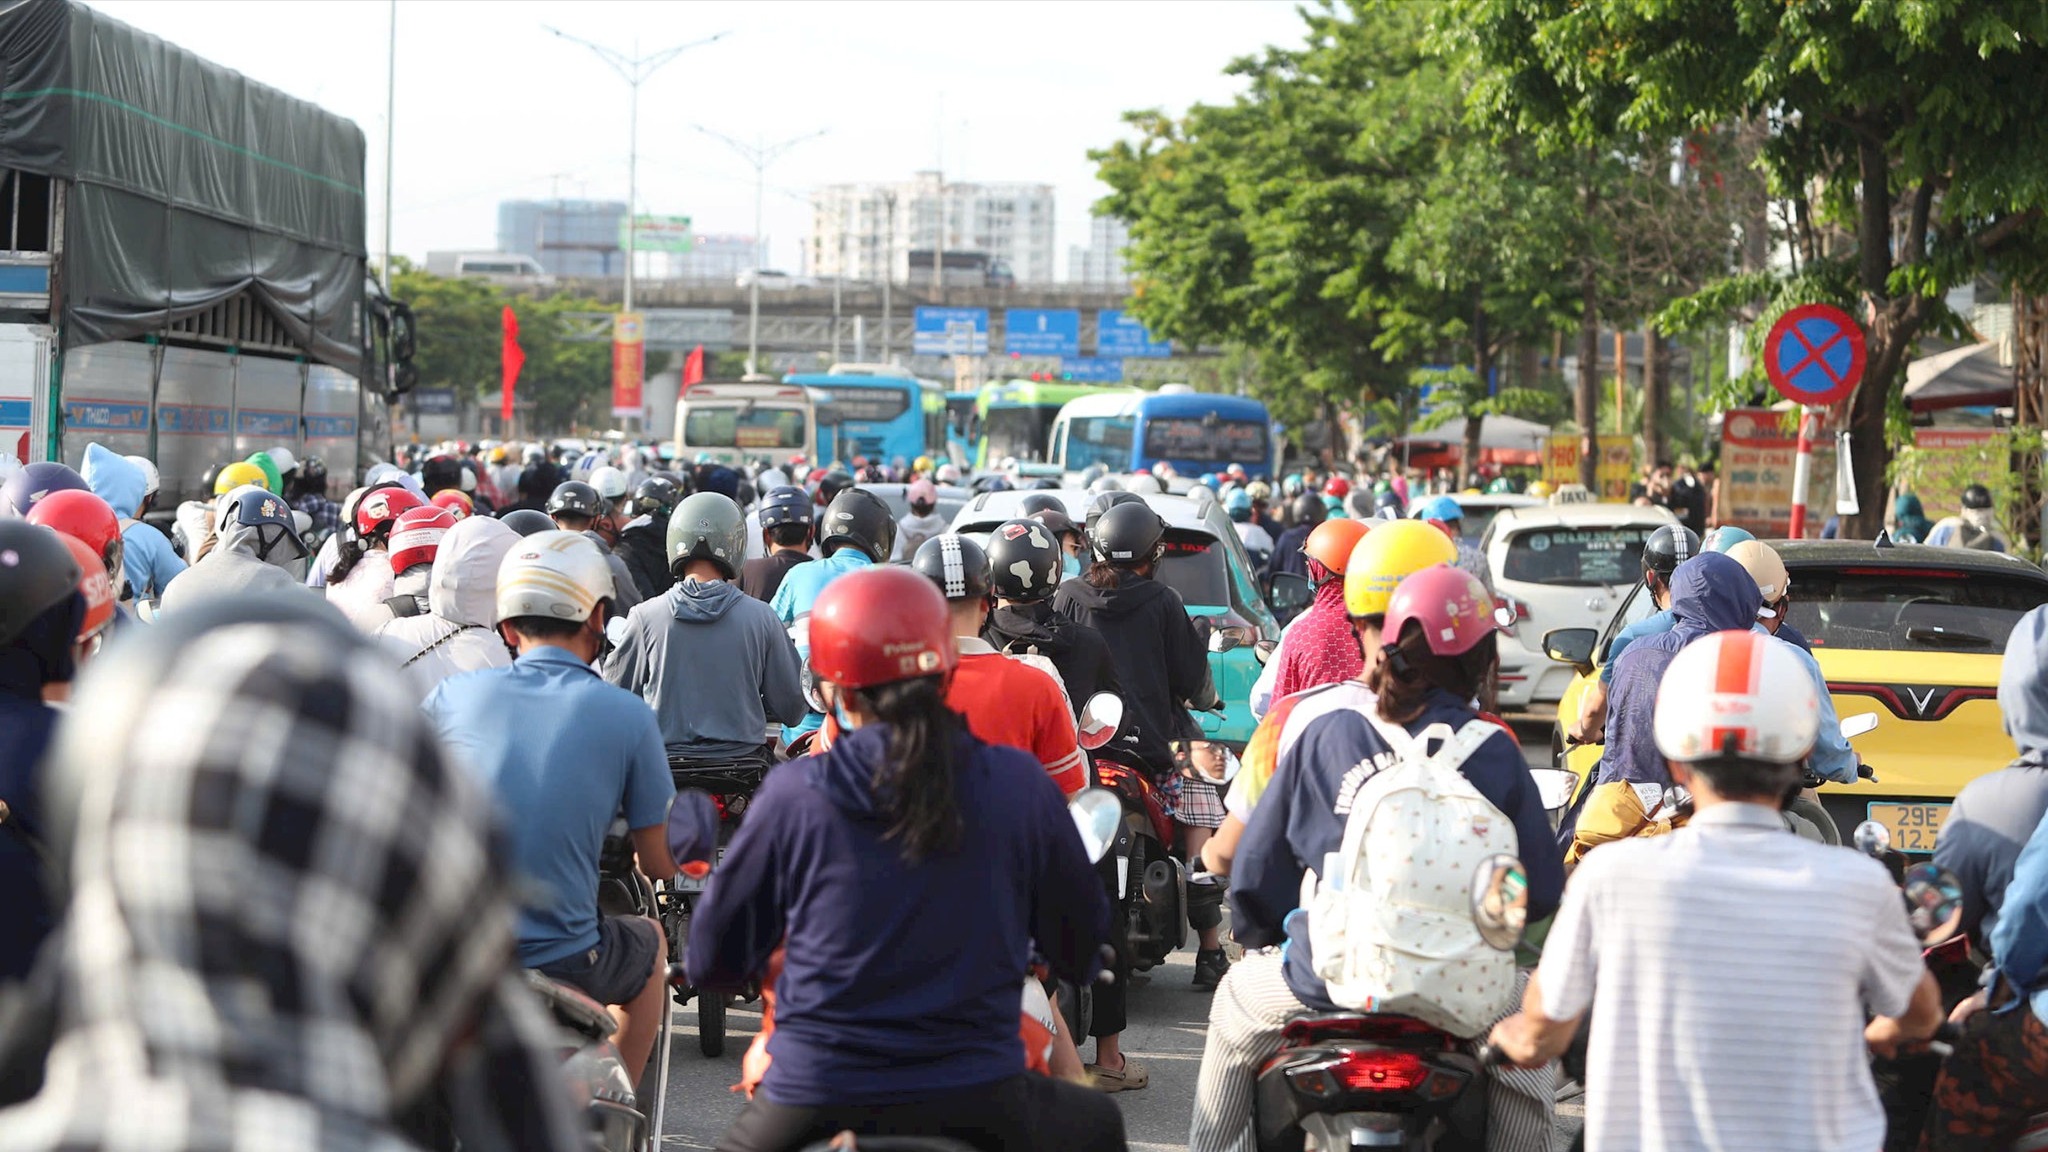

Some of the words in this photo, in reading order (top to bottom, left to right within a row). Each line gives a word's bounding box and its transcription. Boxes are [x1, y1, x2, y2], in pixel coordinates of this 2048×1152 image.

[1561, 490, 1588, 504] TAXI
[1897, 807, 1938, 827] 29E
[1895, 828, 1938, 850] 12.7
